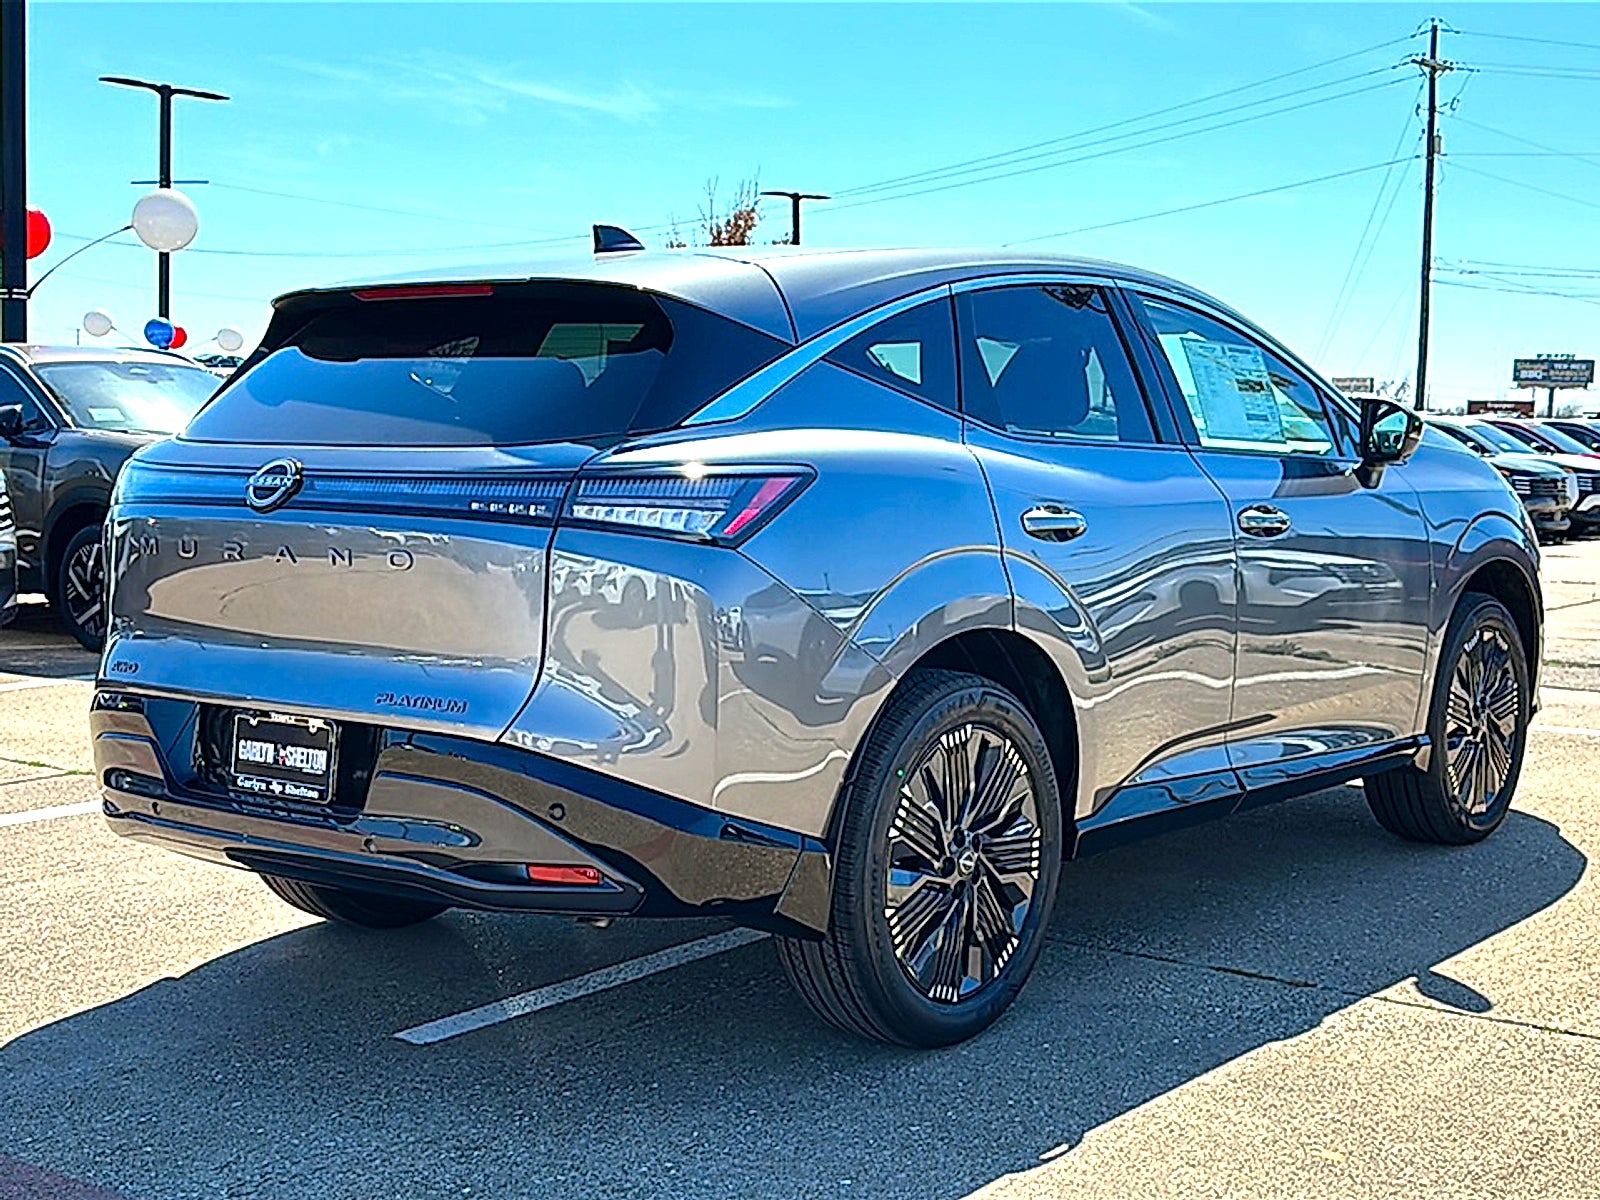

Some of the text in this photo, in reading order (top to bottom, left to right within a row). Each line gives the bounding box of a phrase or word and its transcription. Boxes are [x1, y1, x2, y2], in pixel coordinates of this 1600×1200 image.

[252, 474, 292, 488] NISSAN
[138, 536, 416, 572] MURANO
[376, 692, 469, 714] PLATINUM
[285, 745, 328, 772] SHELTON
